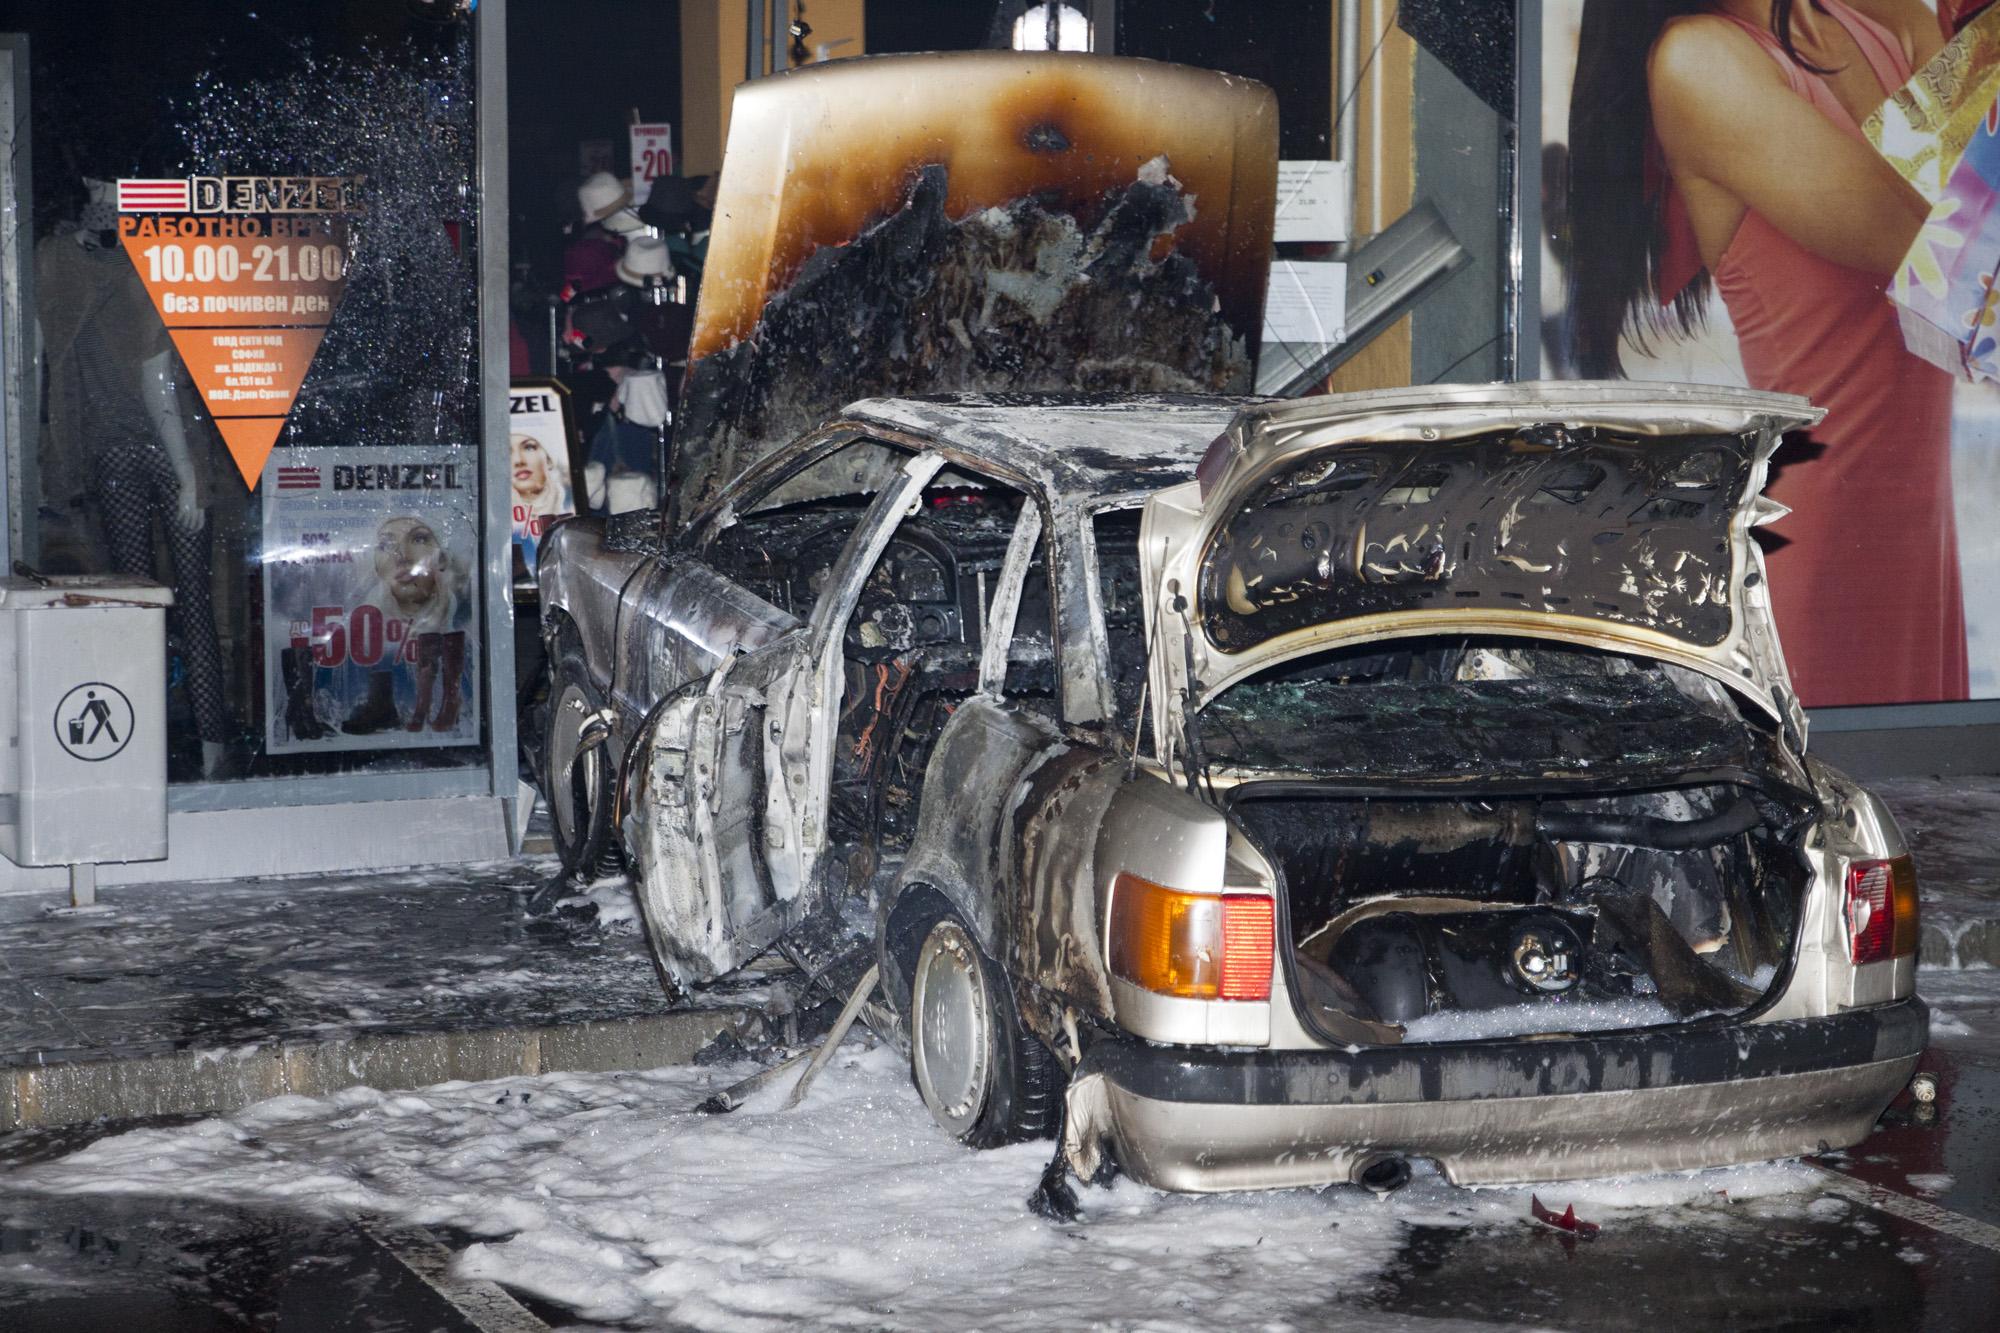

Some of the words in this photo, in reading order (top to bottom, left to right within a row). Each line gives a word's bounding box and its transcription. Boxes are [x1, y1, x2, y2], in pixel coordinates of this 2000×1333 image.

[193, 177, 367, 213] DENZEL
[118, 217, 261, 238] РАБОТНО
[144, 244, 343, 282] 10.00-21.00
[163, 292, 200, 313] без
[203, 295, 288, 313] почивен
[291, 295, 330, 315] ден
[509, 395, 557, 414] ZEL
[333, 464, 463, 490] DENZEL
